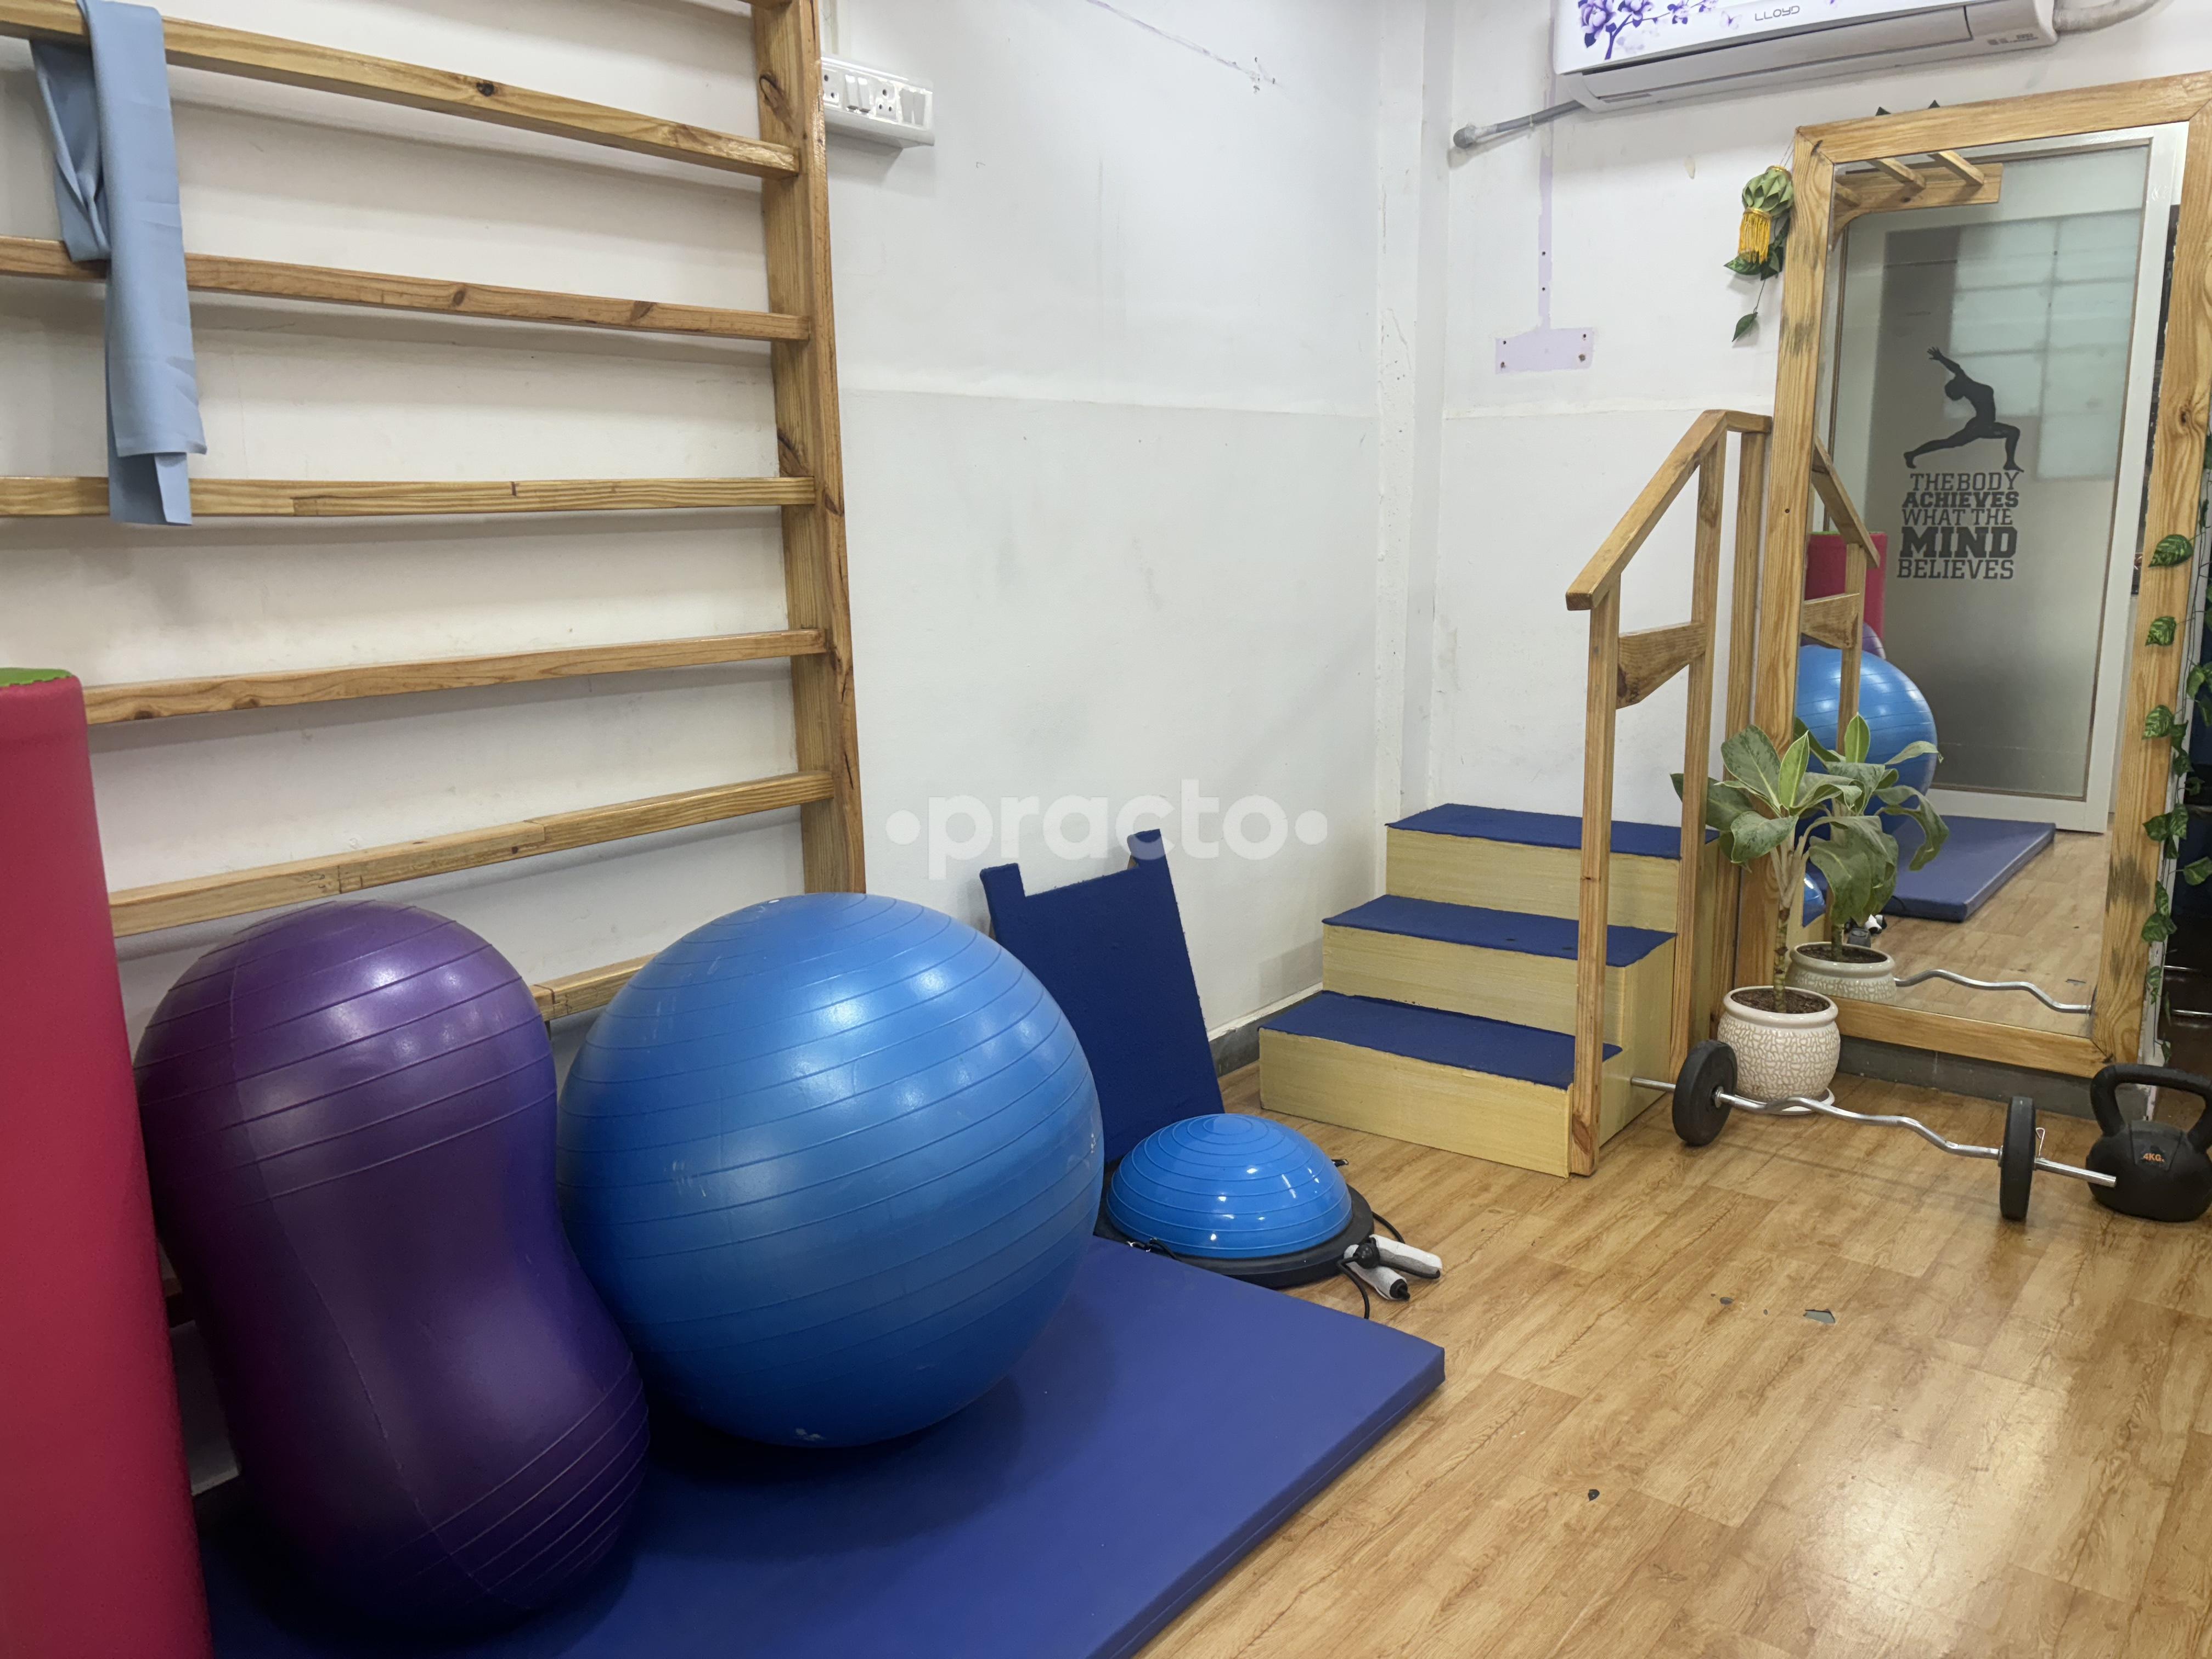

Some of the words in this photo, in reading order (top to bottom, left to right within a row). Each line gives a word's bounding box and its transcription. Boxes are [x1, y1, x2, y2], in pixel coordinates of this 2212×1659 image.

[1754, 5, 1800, 21] LLOYD
[1901, 491, 2019, 508] ACHIEVES
[1901, 509, 1966, 525] WHAT
[1971, 508, 2013, 525] THE
[1899, 526, 2018, 558] MIND
[1897, 558, 2014, 579] BELIEVES
